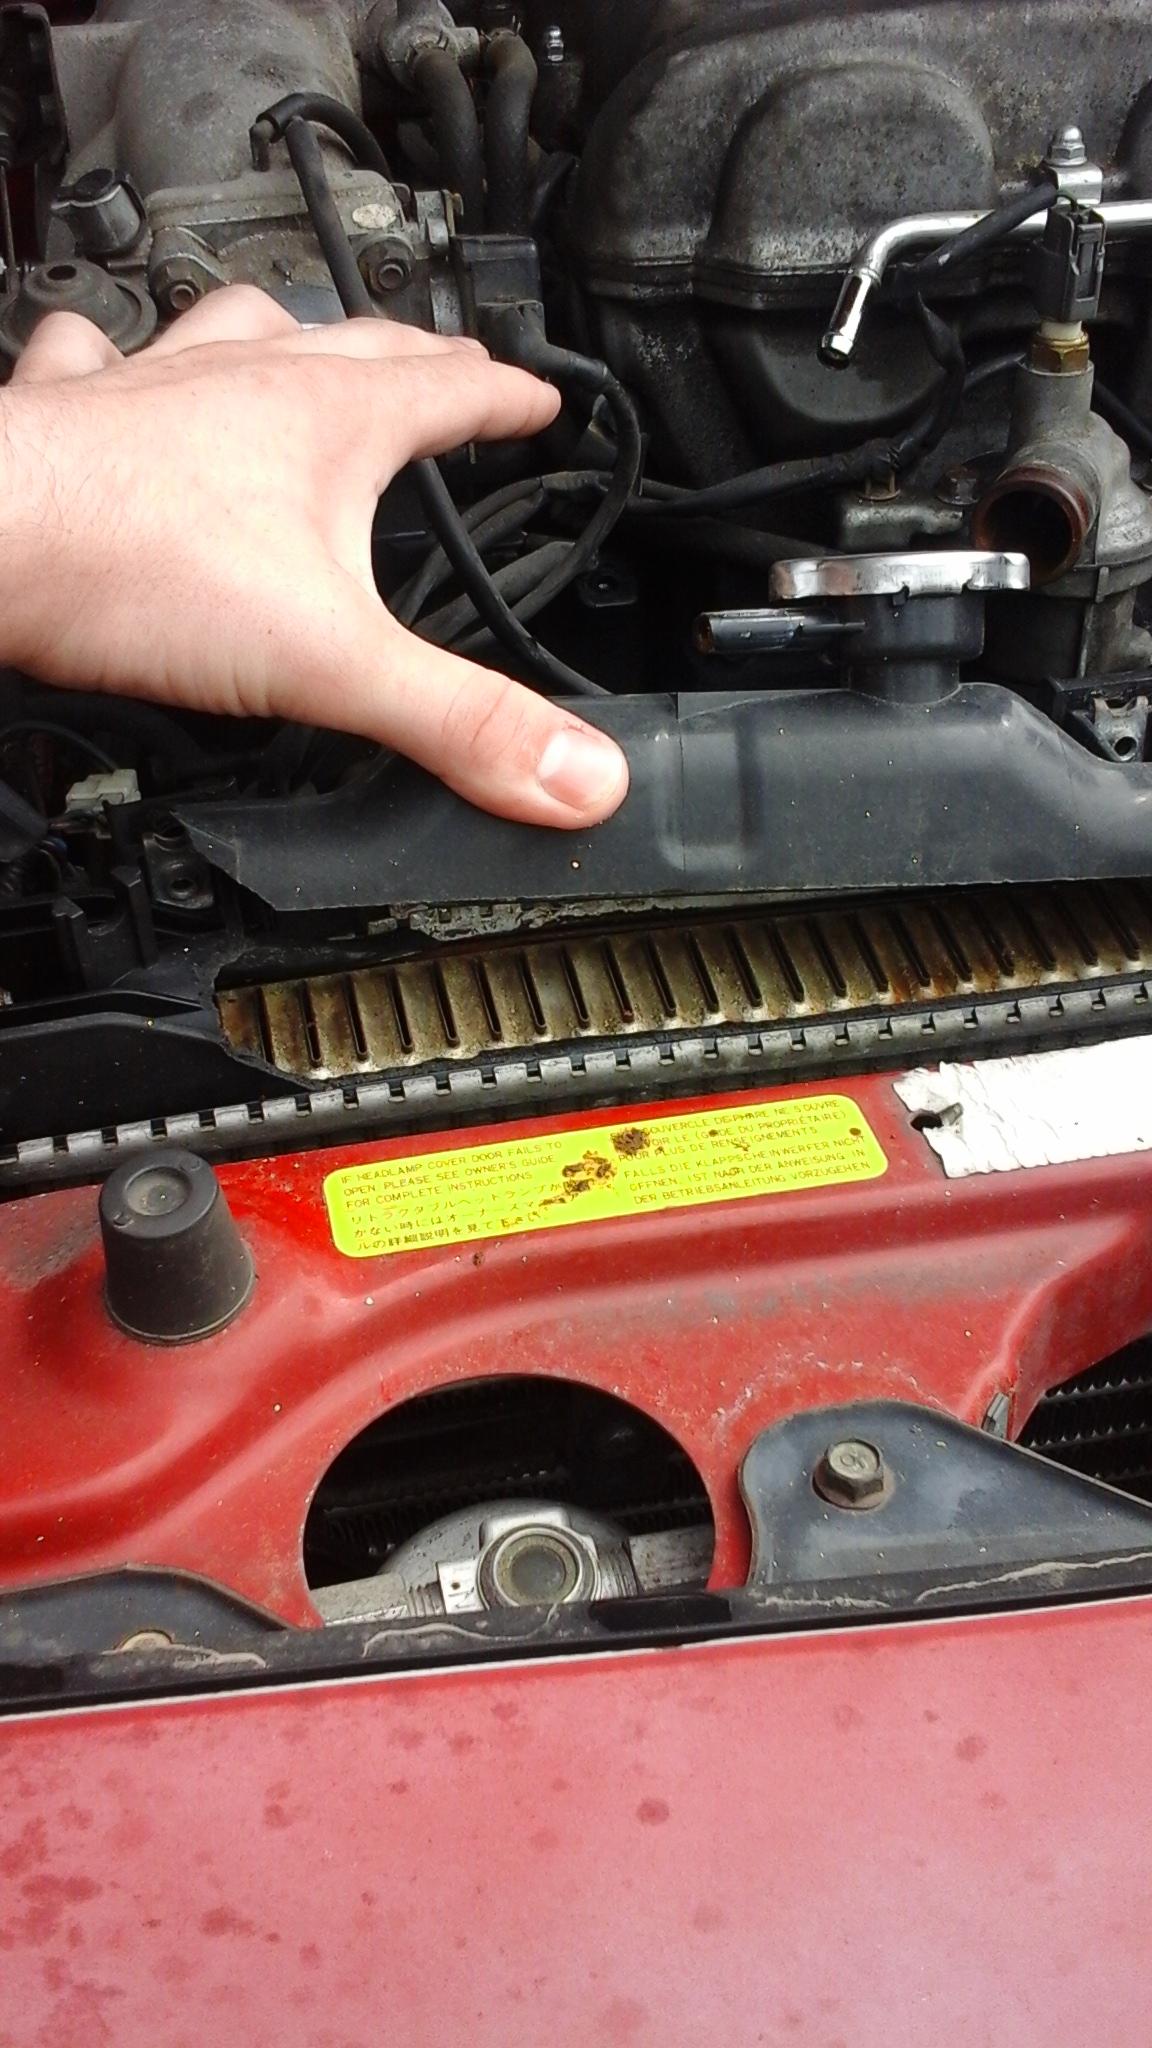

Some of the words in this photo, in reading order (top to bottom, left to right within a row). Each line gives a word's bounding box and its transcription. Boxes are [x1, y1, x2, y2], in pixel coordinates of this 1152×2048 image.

[618, 1150, 649, 1163] POUR
[654, 1145, 686, 1156] PLUS
[690, 1142, 706, 1152] DE
[674, 1133, 690, 1143] LE
[738, 1124, 755, 1134] DU
[341, 1175, 352, 1185] IF
[357, 1163, 423, 1181] HEADLAMP
[427, 1156, 466, 1170] COVER
[471, 1150, 503, 1163] DOOR
[507, 1144, 542, 1157] FAILS
[546, 1140, 562, 1150] TO
[343, 1184, 376, 1197] OPEN
[383, 1174, 431, 1190] PLEASE
[436, 1170, 460, 1181] SEE
[464, 1160, 517, 1177] OWNER'S
[521, 1154, 556, 1167] GUIDE
[624, 1165, 666, 1179] FALLS
[670, 1161, 691, 1173] DIE
[833, 1135, 866, 1147] NICHT
[687, 1172, 709, 1183] IST
[748, 1162, 773, 1174] DER
[851, 1148, 866, 1157] IN
[346, 1197, 370, 1209] FOR
[375, 1185, 442, 1204] COMPLETE
[448, 1171, 533, 1191] INSTRUCTIONS
[633, 1193, 658, 1205] DER
[790, 1160, 871, 1180] VORZUGEHEN
